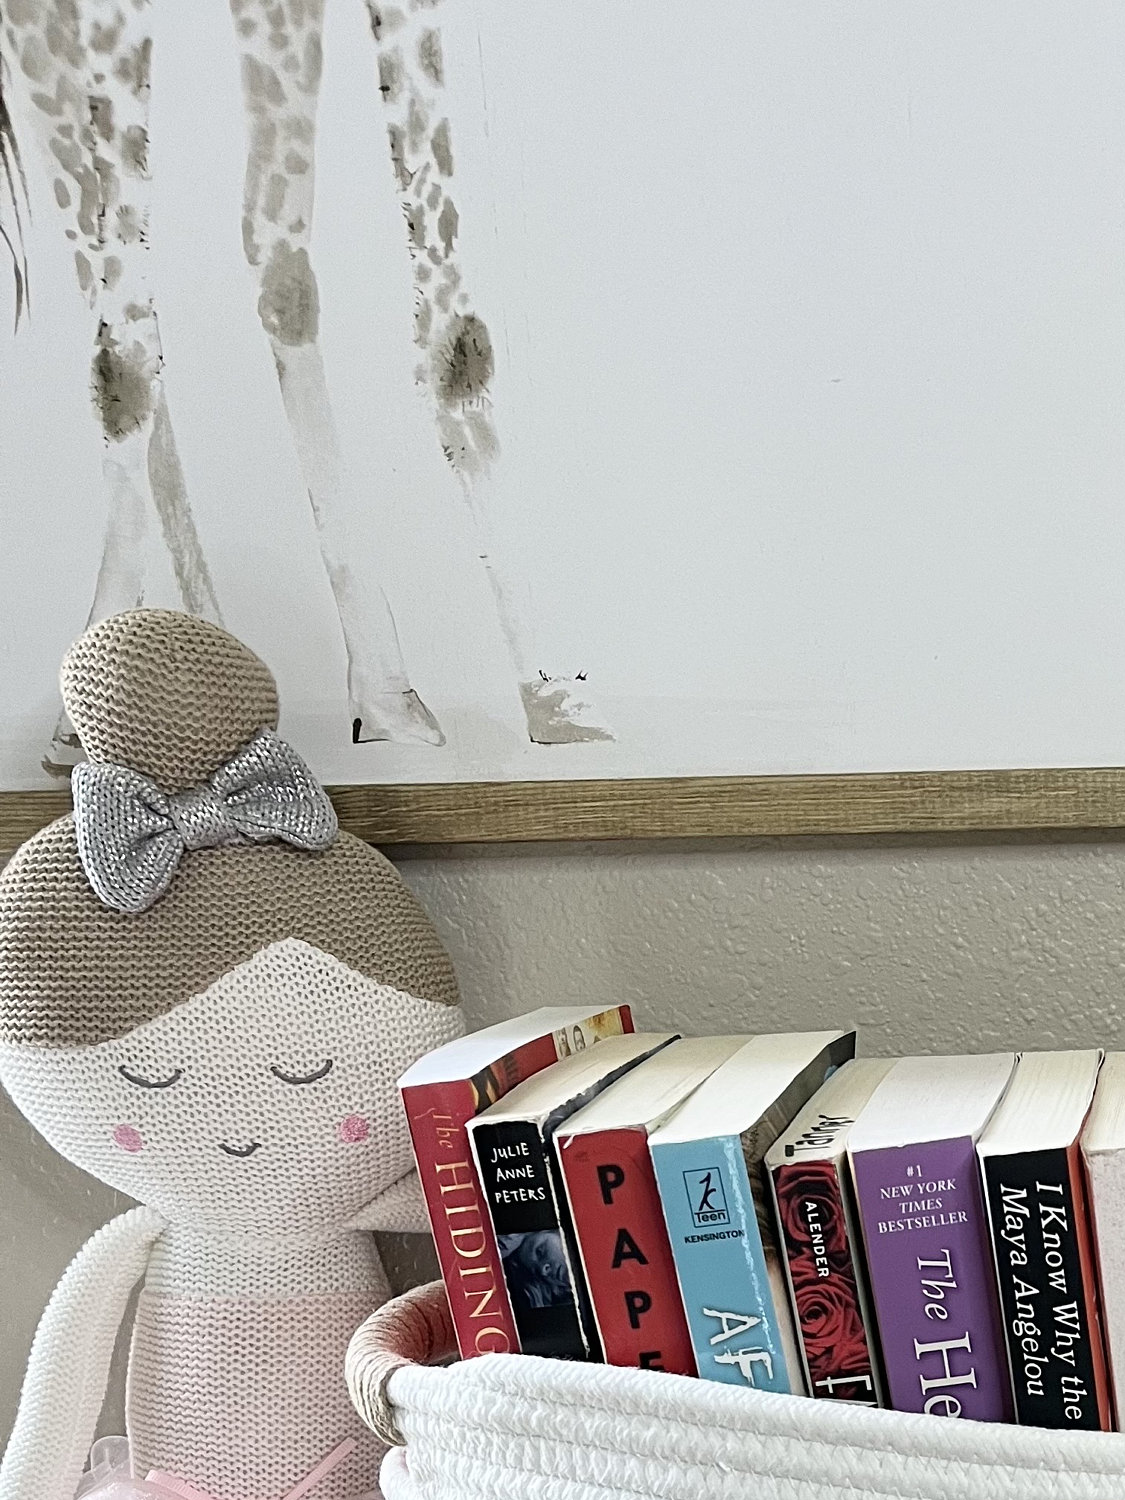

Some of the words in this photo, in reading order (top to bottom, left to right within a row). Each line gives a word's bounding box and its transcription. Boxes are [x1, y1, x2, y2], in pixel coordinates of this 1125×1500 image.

[490, 1142, 530, 1163] JULIE
[496, 1166, 535, 1180] ANNE
[906, 1165, 923, 1178] #1
[495, 1186, 546, 1204] PETERS
[880, 1186, 913, 1200] NEW
[917, 1178, 957, 1193] YORK
[1036, 1180, 1063, 1195] I
[694, 1209, 727, 1223] Teen
[899, 1198, 943, 1214] TIMES
[877, 1211, 968, 1234] BESTSELLER
[1000, 1184, 1031, 1266] Maya
[684, 1229, 745, 1244] KENSINGTON
[804, 1201, 830, 1278] ALENDER
[1038, 1202, 1068, 1294] Know
[435, 1161, 510, 1355] HIDING
[917, 1248, 958, 1321] The
[1013, 1278, 1049, 1397] Angelou
[1051, 1300, 1079, 1367] Why
[913, 1331, 979, 1418] He
[1061, 1376, 1088, 1420] the
